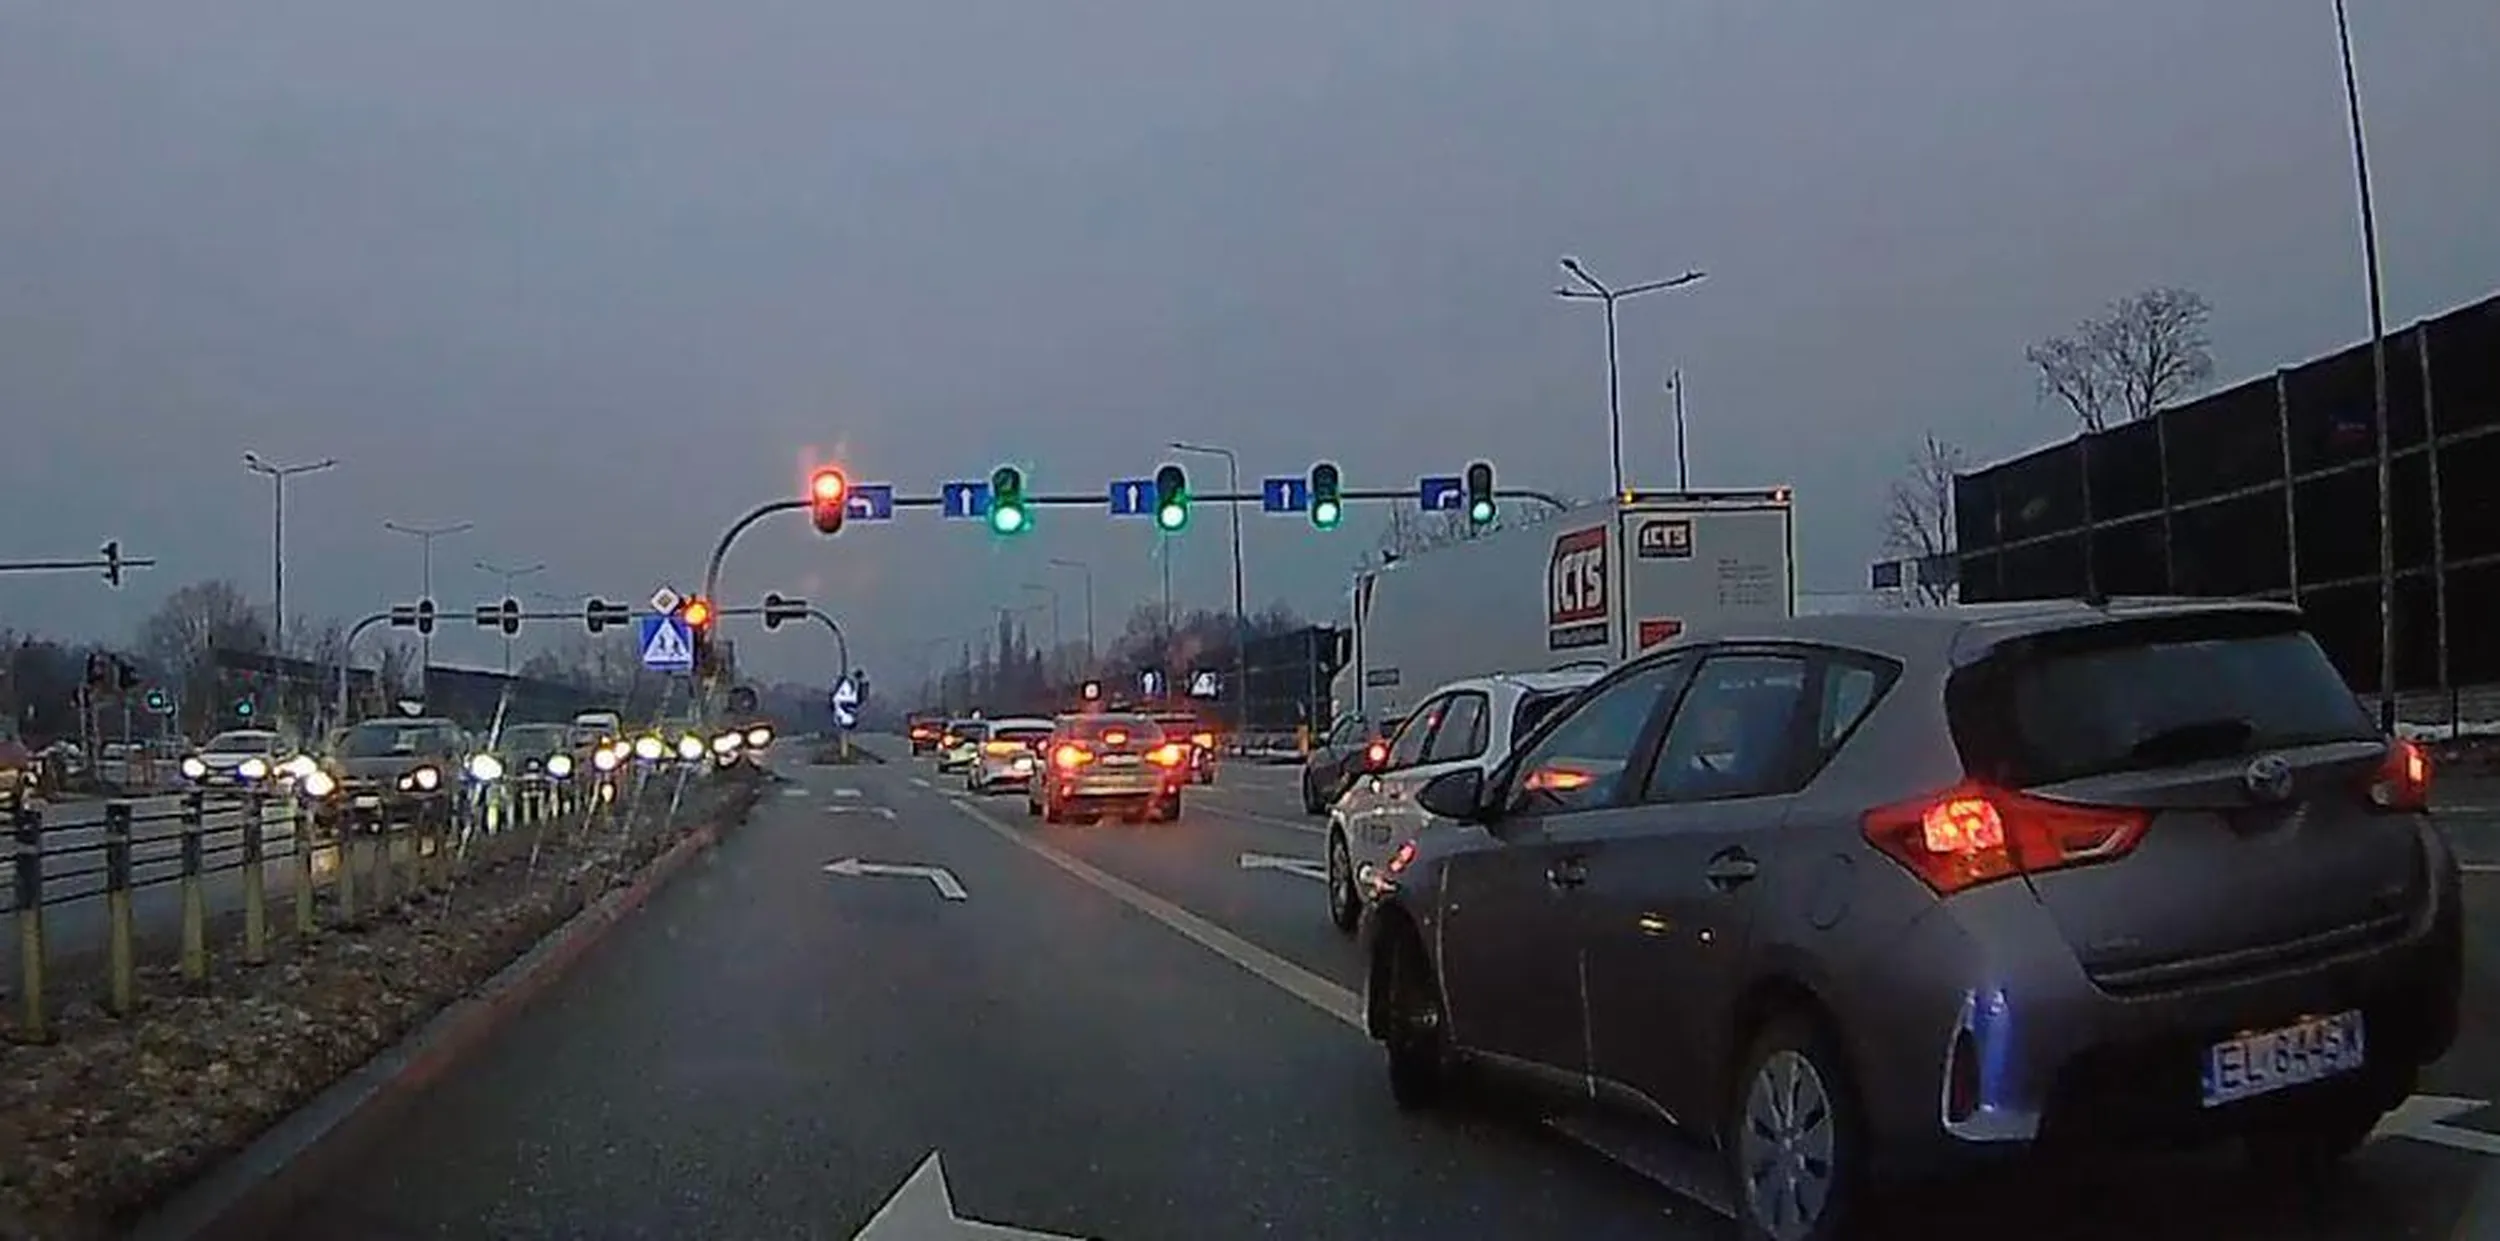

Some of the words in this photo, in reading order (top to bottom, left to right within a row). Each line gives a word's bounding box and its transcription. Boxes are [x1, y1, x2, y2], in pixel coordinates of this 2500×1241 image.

[1643, 527, 1686, 546] ICTS
[1554, 548, 1602, 613] ICTS
[2219, 1042, 2263, 1088] EL
